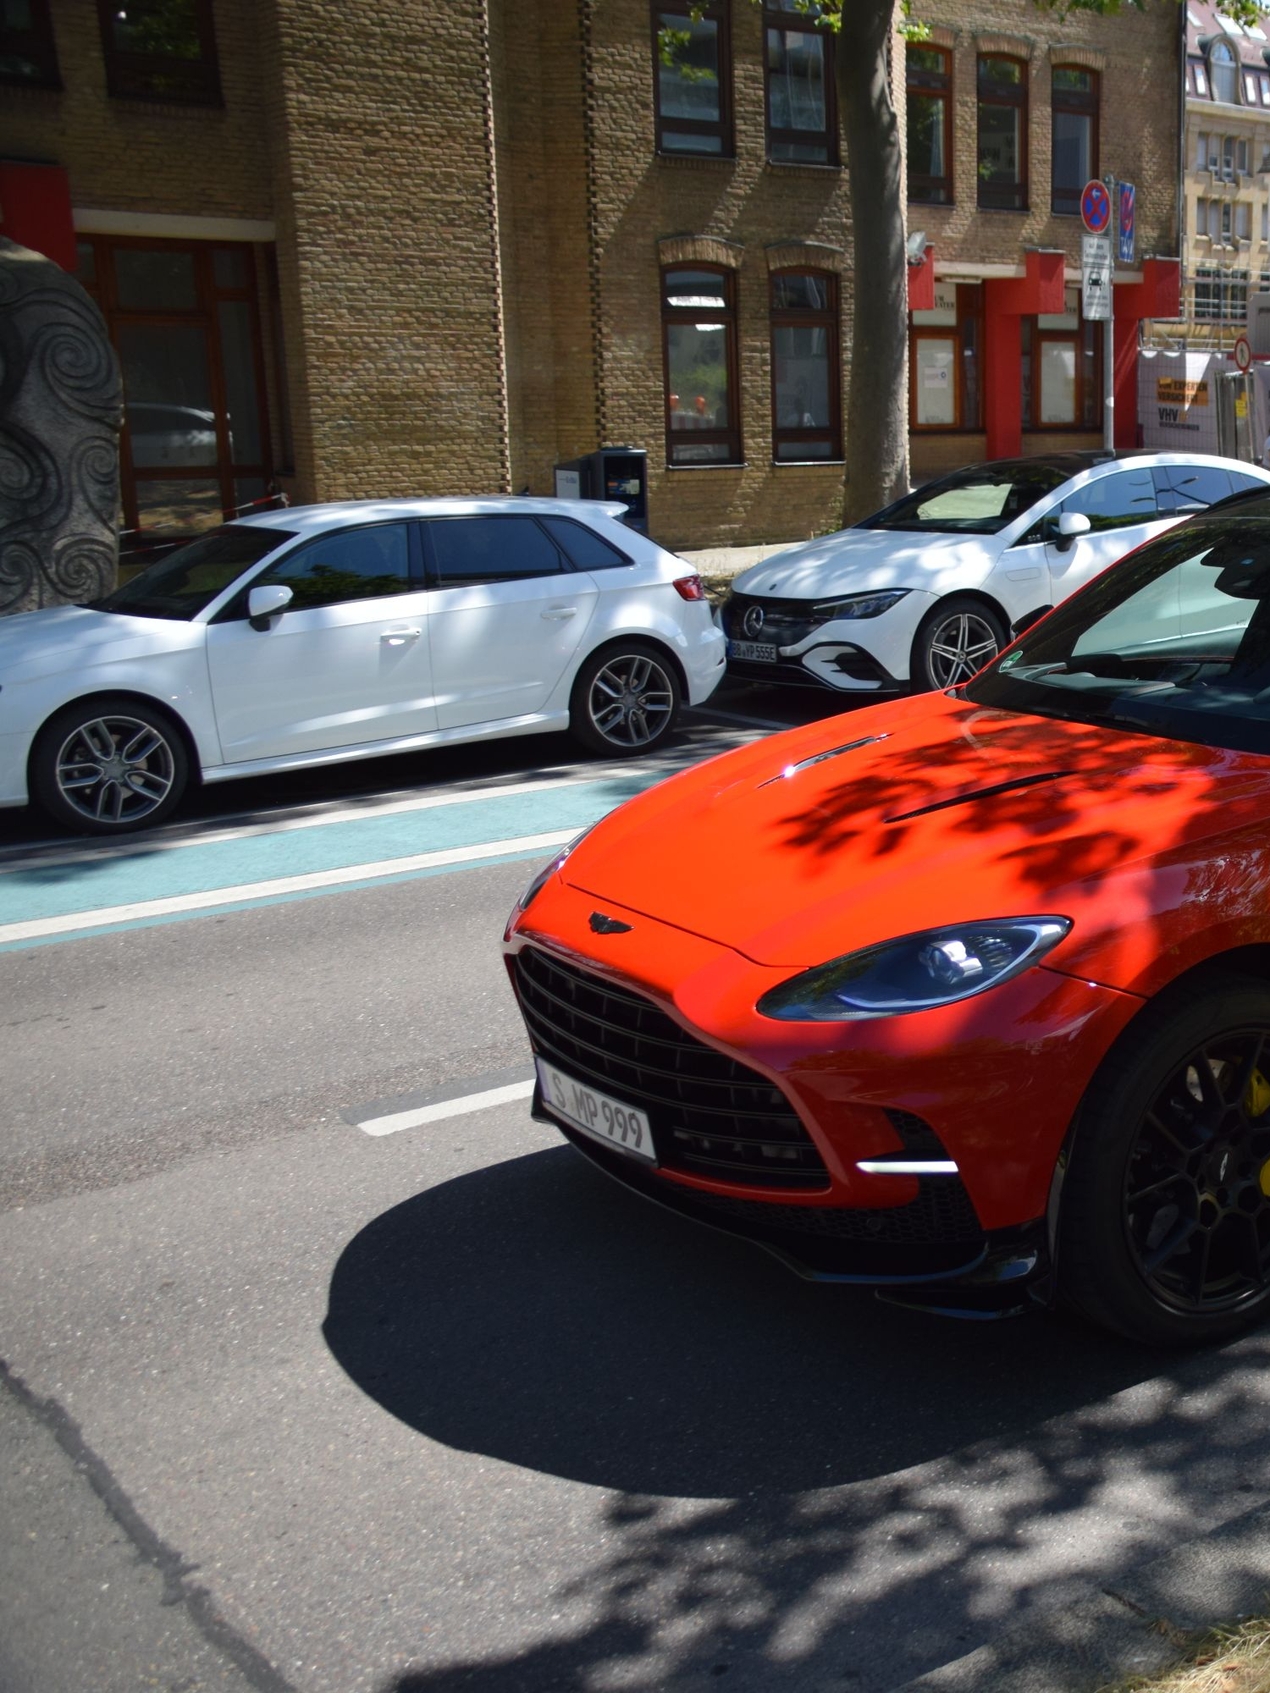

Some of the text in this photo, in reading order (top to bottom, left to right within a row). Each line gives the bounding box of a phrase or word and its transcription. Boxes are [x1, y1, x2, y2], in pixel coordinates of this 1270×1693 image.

[1158, 408, 1179, 422] VHV
[552, 1073, 566, 1109] S
[601, 1100, 643, 1149] 999
